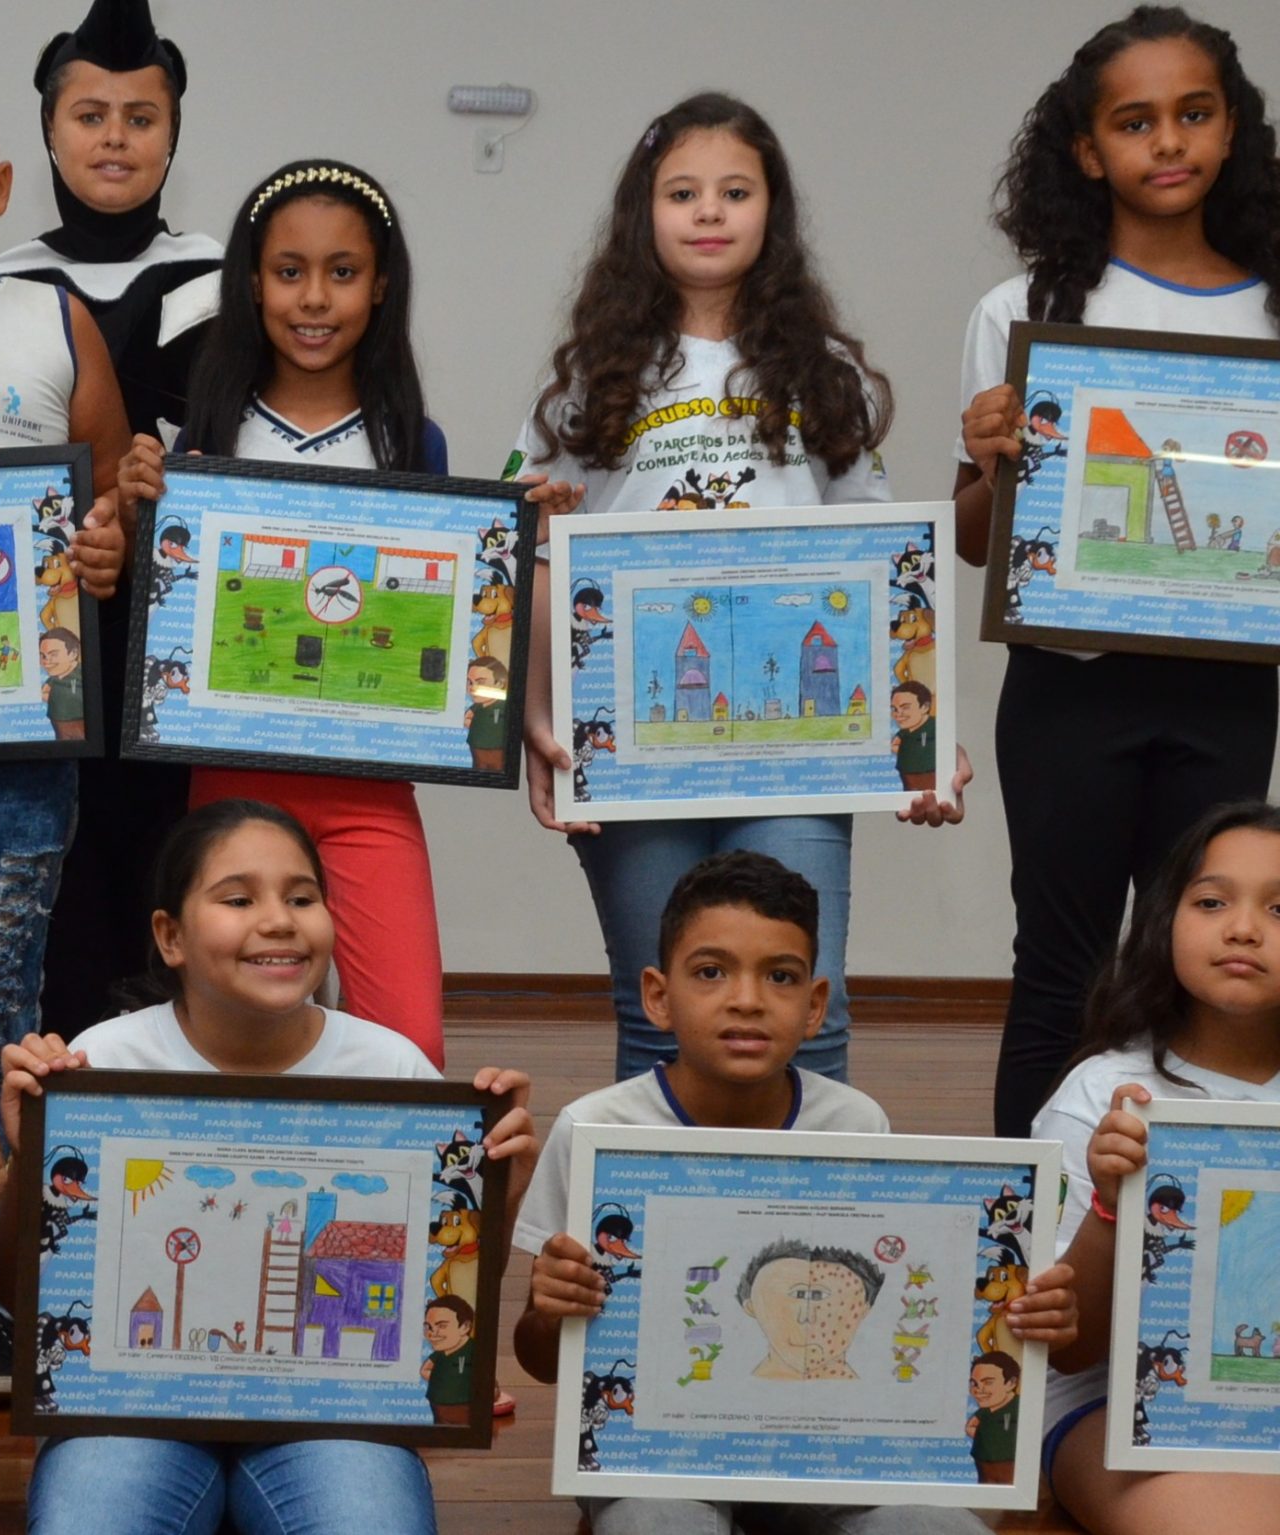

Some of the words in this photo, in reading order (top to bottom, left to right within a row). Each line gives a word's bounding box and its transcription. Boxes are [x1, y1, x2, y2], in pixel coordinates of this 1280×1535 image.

[1, 415, 43, 433] UNIFORME
[619, 397, 716, 456] ONCURSO
[727, 435, 746, 446] DA
[636, 452, 698, 472] COMBATE
[700, 453, 719, 464] AO
[723, 449, 763, 463] Aedes
[65, 1113, 123, 1122] PARABÉNS
[141, 1111, 198, 1120] PARABÉNS
[204, 1119, 262, 1128] PARABÉNS
[280, 1117, 337, 1126] PARABÉNS
[345, 1119, 402, 1129] PARABÉNS
[415, 1122, 473, 1132] PARABÉNS
[113, 1128, 170, 1137] PARABÉNS
[177, 1131, 234, 1141] PARABÉNS
[252, 1133, 309, 1143] PARABÉNS
[324, 1135, 381, 1145] PARABÉNS
[1164, 1141, 1221, 1152] PARABÉNS
[1149, 1157, 1205, 1168] PARABÉNS
[1210, 1157, 1266, 1167] PARABÉNS
[611, 1170, 669, 1179] PARABÉNS
[687, 1167, 744, 1177] PARABÉNS
[751, 1175, 809, 1185] PARABÉNS
[827, 1172, 884, 1182] PARABÉNS
[892, 1174, 950, 1184] PARABÉNS
[963, 1177, 1021, 1186] PARABÉNS
[658, 1184, 716, 1194] PARABÉNS
[723, 1188, 781, 1197] PARABÉNS
[799, 1189, 856, 1199] PARABÉNS
[871, 1191, 929, 1200] PARABÉNS
[189, 1379, 246, 1389] PARABÉNS
[98, 1388, 155, 1398] PARABÉNS
[171, 1395, 228, 1405] PARABÉNS
[236, 1394, 292, 1403] PARABÉNS
[311, 1397, 367, 1406] PARABÉNS
[262, 1408, 319, 1418] PARABÉNS
[336, 1412, 393, 1421] PARABÉNS
[1190, 1420, 1247, 1429] PARABÉNS
[732, 1438, 789, 1447] PARABÉNS
[882, 1439, 939, 1448] PARABÉNS
[1216, 1435, 1272, 1444] PARABÉNS
[641, 1448, 698, 1457] PARABÉNS
[714, 1454, 771, 1463] PARABÉNS
[779, 1453, 836, 1462] PARABÉNS
[855, 1455, 911, 1464] PARABÉNS
[667, 1462, 724, 1471] PARABÉNS
[806, 1467, 863, 1476] PARABÉNS
[880, 1470, 938, 1479] PARABÉNS
